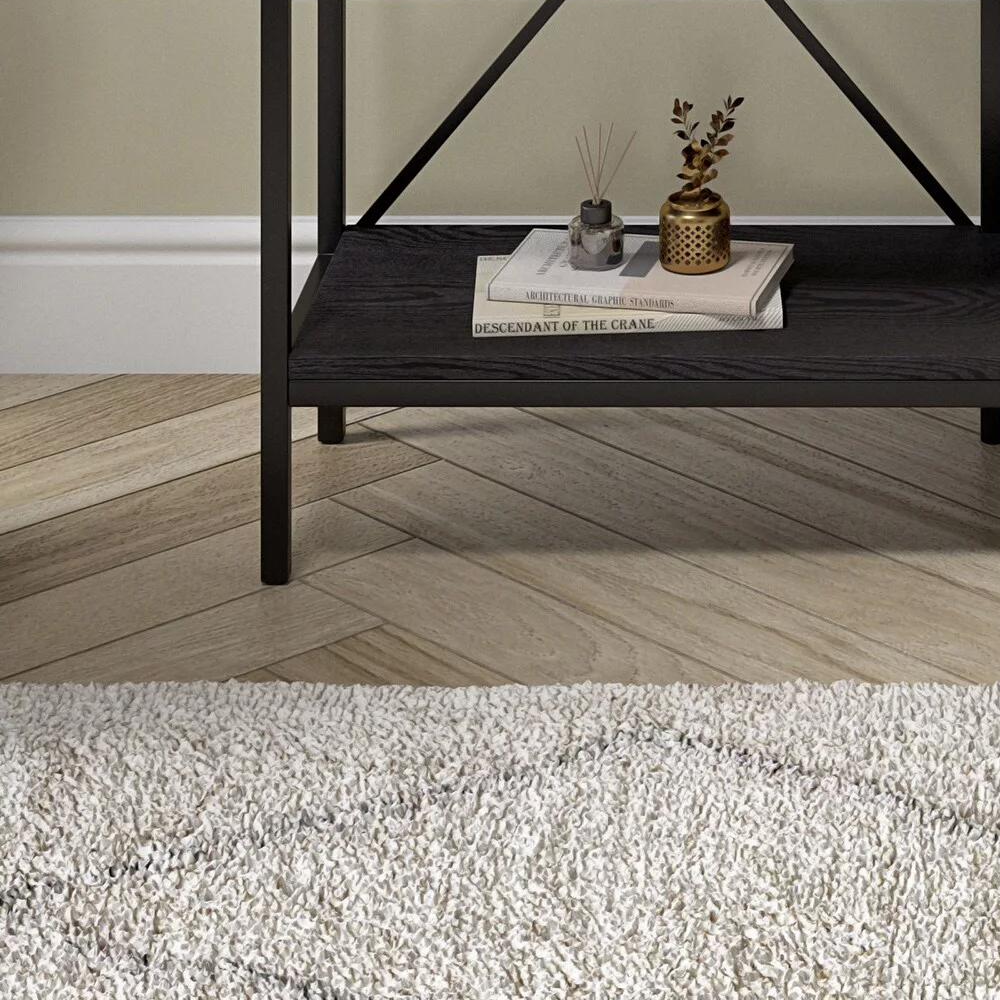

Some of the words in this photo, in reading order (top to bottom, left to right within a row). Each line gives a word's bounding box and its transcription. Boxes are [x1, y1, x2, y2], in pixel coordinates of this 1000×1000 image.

[525, 290, 589, 305] ARCHITECTURAL
[591, 294, 626, 307] GRAPHIC
[629, 297, 675, 309] STANDARDS
[475, 321, 560, 334] DESCENDANT
[562, 320, 579, 332] OF
[582, 319, 607, 331] THE
[611, 318, 656, 331] CRANE
